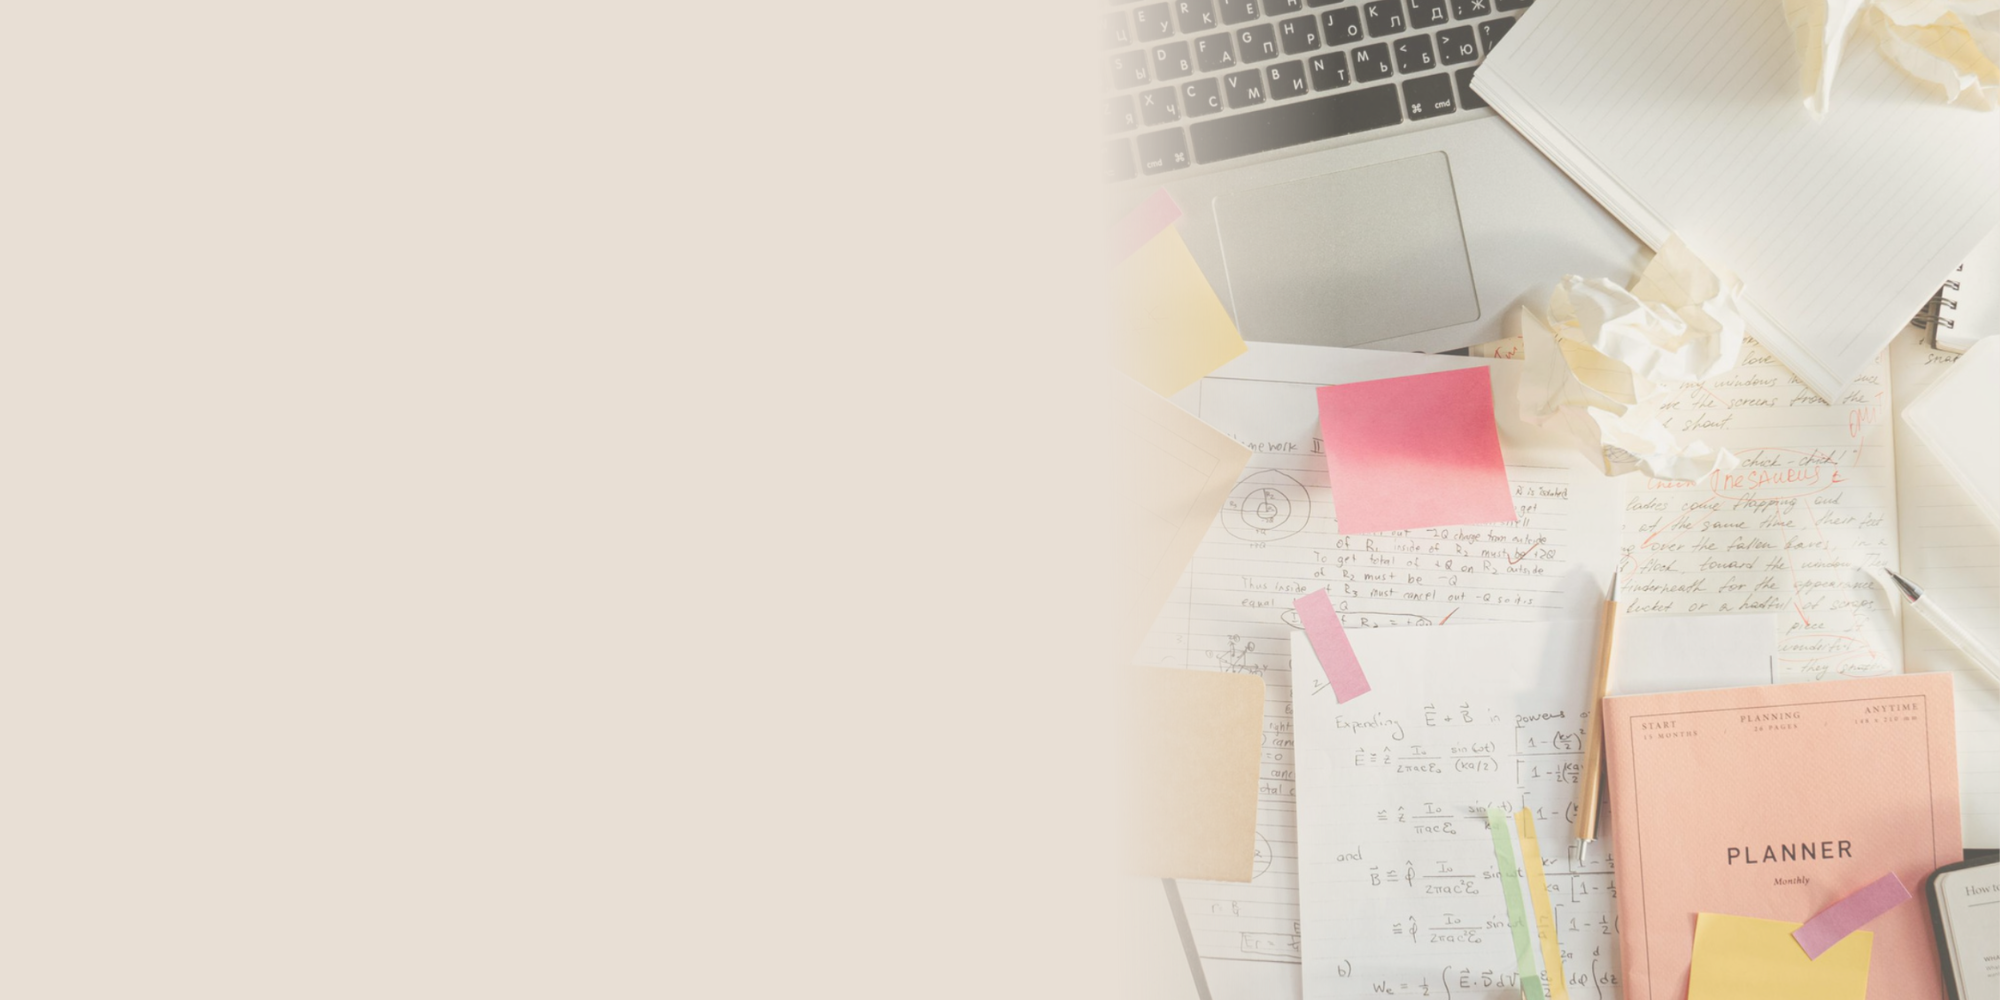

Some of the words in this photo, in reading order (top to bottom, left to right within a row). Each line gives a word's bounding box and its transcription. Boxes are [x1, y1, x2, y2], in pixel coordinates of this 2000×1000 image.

[1180, 3, 1189, 13] R
[1369, 6, 1378, 17] K
[1138, 11, 1145, 22] E
[1327, 15, 1333, 26] J
[1431, 8, 1443, 21] Д
[1390, 16, 1400, 28] Л
[1284, 24, 1294, 35] H
[1242, 32, 1252, 43] G
[1199, 41, 1206, 52] F
[1263, 42, 1273, 53] П
[1459, 44, 1473, 56] Ю
[1157, 50, 1166, 60] D
[1357, 50, 1369, 63] M
[1422, 53, 1430, 64] Б
[1115, 59, 1123, 69] S
[1314, 59, 1324, 71] N
[1271, 69, 1280, 80] B
[1229, 77, 1237, 88] V
[1293, 78, 1303, 90] И
[1187, 86, 1196, 97] C
[1144, 95, 1154, 106] X
[1435, 100, 1451, 110] cmd
[1167, 104, 1176, 115] Ч
[1125, 113, 1134, 125] Я
[1147, 159, 1162, 169] cmd
[1741, 350, 1775, 367] love
[1692, 393, 1717, 410] the
[1727, 397, 1778, 410] screens
[1842, 390, 1869, 404] the
[1814, 491, 1843, 505] and
[1520, 503, 1537, 518] get
[1671, 516, 1693, 531] the
[1701, 521, 1750, 532] same
[1336, 535, 1351, 549] of
[1429, 543, 1440, 554] of
[1481, 548, 1506, 558] must
[1692, 536, 1718, 553] the
[1313, 551, 1327, 563] To
[1337, 553, 1357, 567] get
[1370, 554, 1395, 566] total
[1406, 557, 1419, 568] of
[1460, 564, 1474, 573] on
[1699, 556, 1759, 571] toward
[1764, 556, 1789, 572] the
[1314, 568, 1326, 579] of
[1364, 573, 1397, 582] must
[1407, 573, 1423, 584] be
[1241, 576, 1268, 590] Thus
[1370, 588, 1401, 598] must
[1447, 592, 1466, 602] out
[1719, 576, 1747, 593] for
[1754, 576, 1779, 592] the
[1688, 602, 1708, 612] or
[1719, 603, 1733, 612] a
[1864, 703, 1919, 715] ANYTIME
[1740, 711, 1801, 723] PLANNING
[1335, 712, 1405, 741] Expanding
[1515, 711, 1565, 727] powers
[1642, 720, 1677, 731] START
[1768, 723, 1799, 731] PAGES
[1657, 730, 1699, 740] MONTHS
[1336, 846, 1363, 862] and
[1727, 840, 1853, 865] PLANNER
[1773, 875, 1810, 887] Monthly
[1965, 885, 1990, 897] How
[1337, 959, 1352, 977] b)
